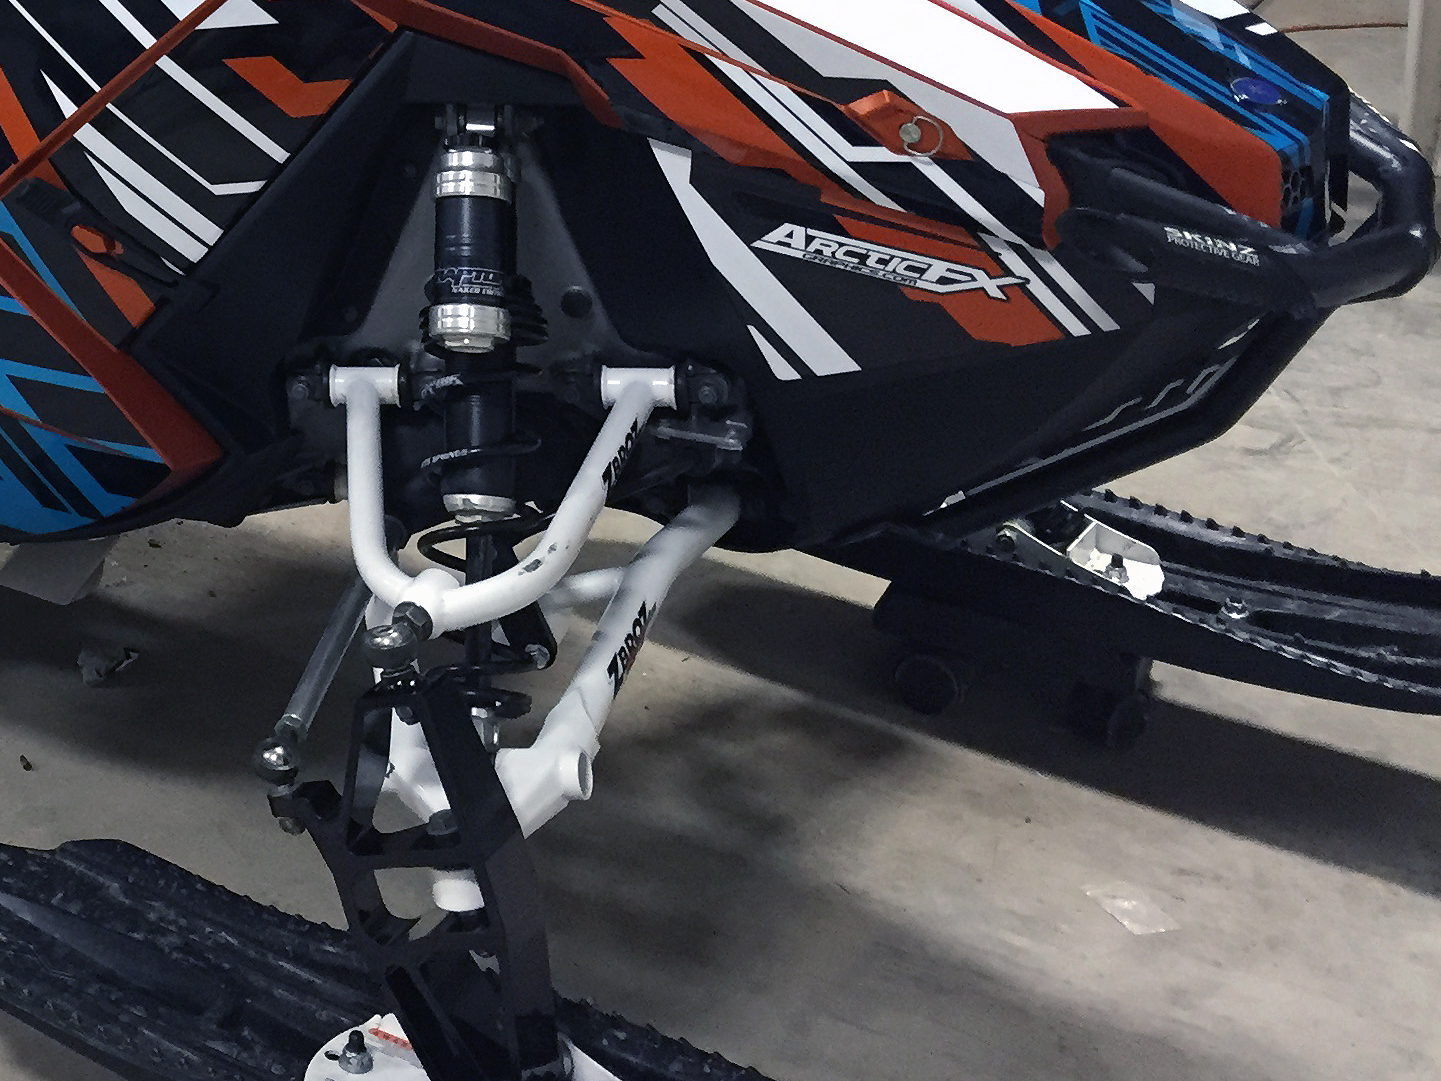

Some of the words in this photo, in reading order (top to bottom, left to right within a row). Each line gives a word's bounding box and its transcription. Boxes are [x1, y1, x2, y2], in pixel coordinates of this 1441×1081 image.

[1163, 226, 1256, 254] SKINZ
[1166, 234, 1231, 259] PROTECTIVE
[1231, 251, 1260, 267] GEAR
